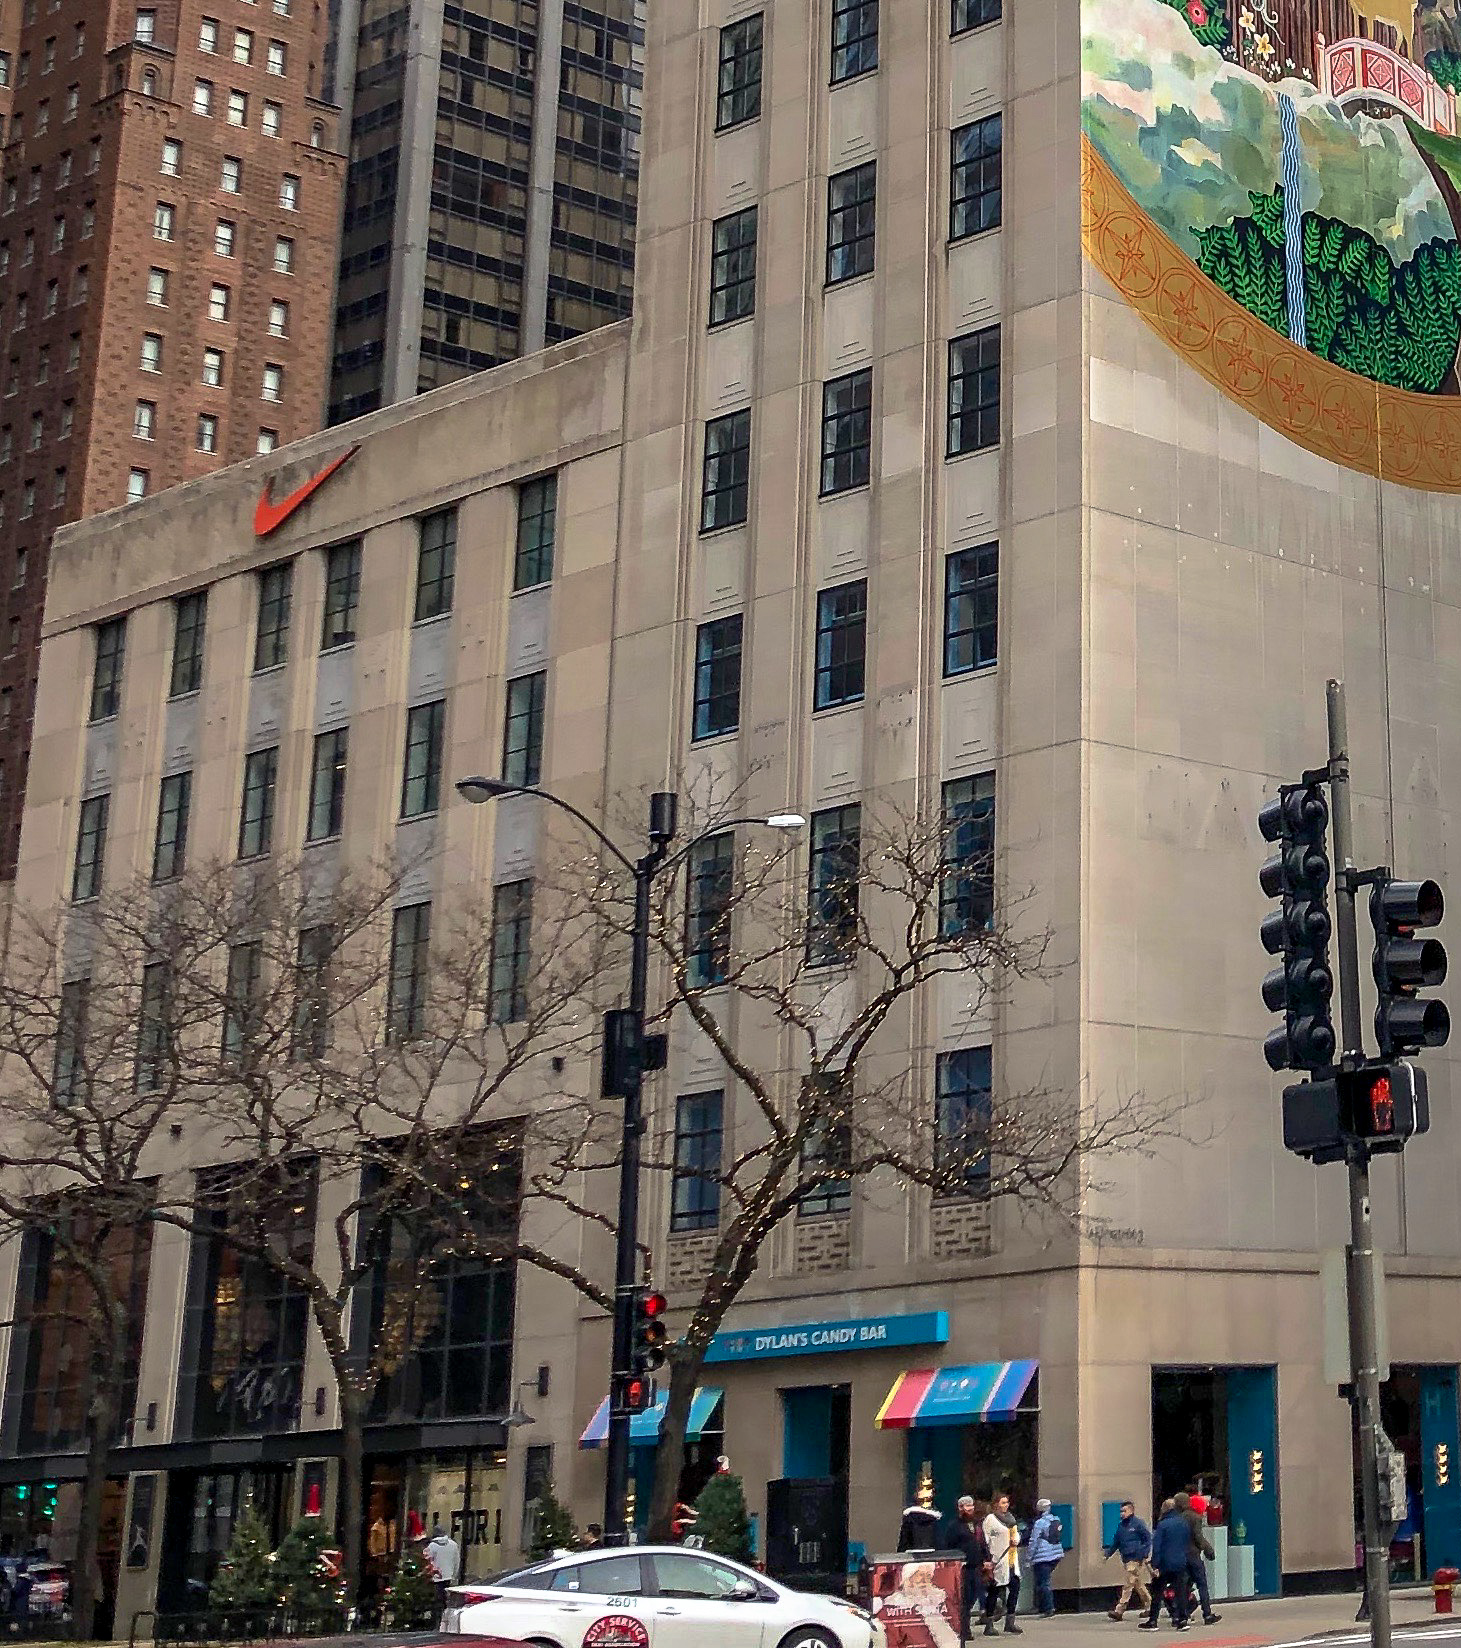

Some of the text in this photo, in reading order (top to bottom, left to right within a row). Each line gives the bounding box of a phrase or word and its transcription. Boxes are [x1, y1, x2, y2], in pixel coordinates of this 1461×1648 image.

[755, 1324, 888, 1351] DYLAN'S CANDY BAR
[606, 1595, 638, 1608] 2501
[586, 1616, 647, 1643] CITY SERVICE
